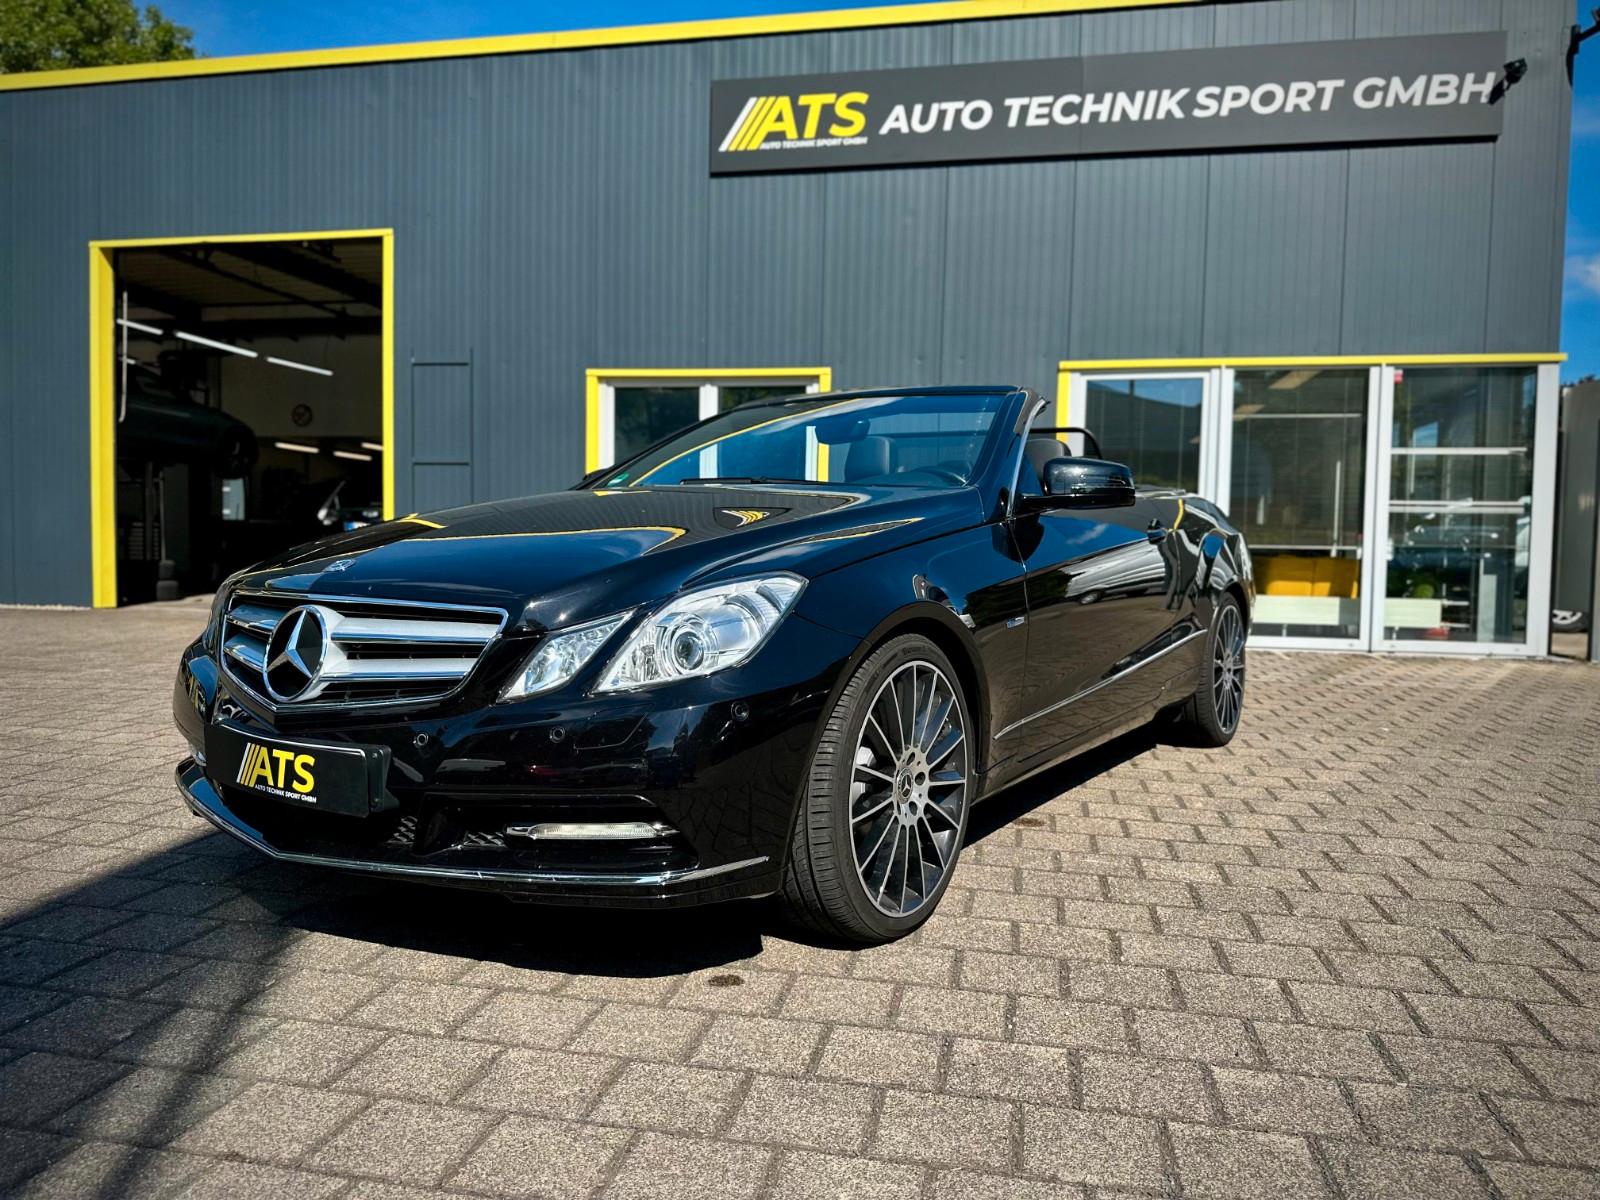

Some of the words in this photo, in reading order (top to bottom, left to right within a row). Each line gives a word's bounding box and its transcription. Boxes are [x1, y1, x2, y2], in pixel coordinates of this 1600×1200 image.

[747, 92, 869, 151] ATS
[879, 100, 994, 135] AUTO
[1004, 87, 1191, 128] TECHNIK
[1192, 79, 1345, 118] SPORT
[1353, 72, 1497, 109] GMBH
[249, 747, 315, 793] ATS
